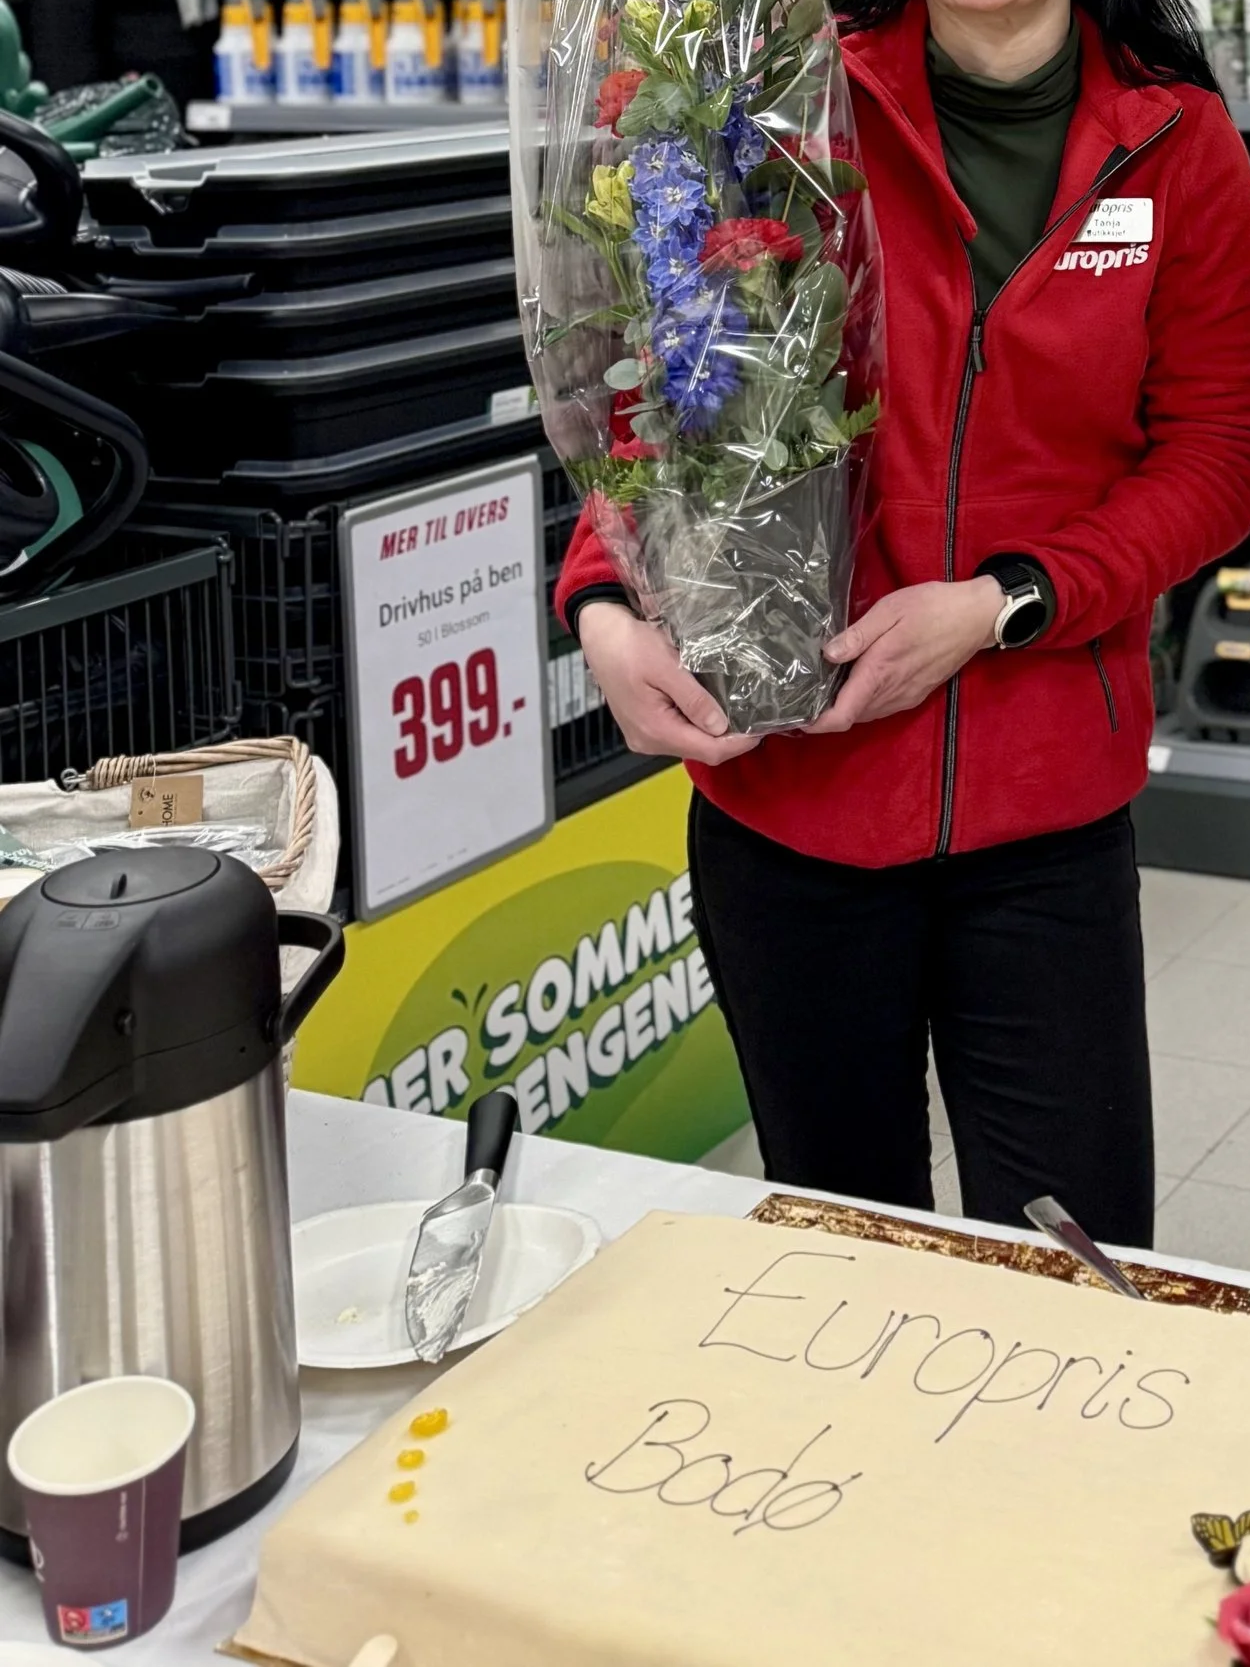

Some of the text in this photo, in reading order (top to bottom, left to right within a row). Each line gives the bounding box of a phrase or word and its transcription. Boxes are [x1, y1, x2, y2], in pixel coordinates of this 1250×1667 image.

[1095, 219, 1120, 228] Tanja
[379, 496, 510, 560] MER TIL OVERS
[379, 560, 523, 628] Drivhus på ben
[417, 629, 433, 647] 50
[441, 610, 491, 639] Blossom
[392, 647, 526, 780] 399.-
[497, 946, 714, 1135] ENGENE
[698, 1251, 1190, 1442] Europris
[585, 1398, 863, 1536] Bodø
